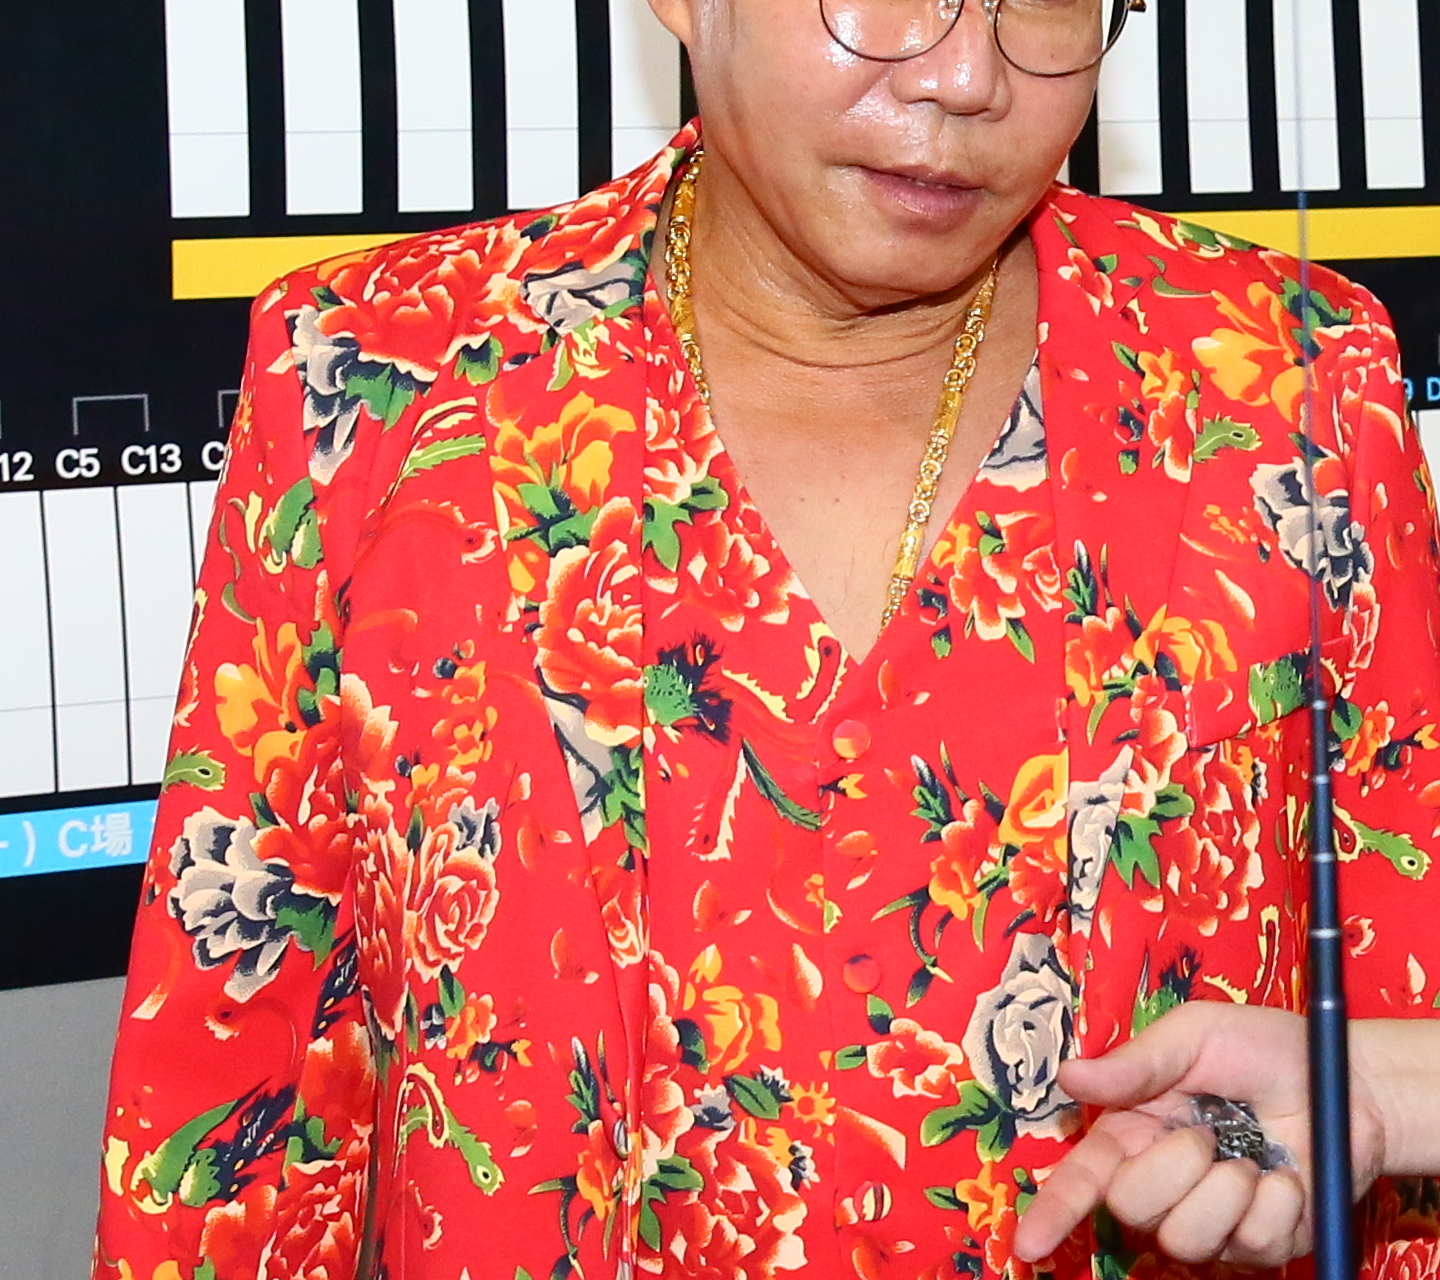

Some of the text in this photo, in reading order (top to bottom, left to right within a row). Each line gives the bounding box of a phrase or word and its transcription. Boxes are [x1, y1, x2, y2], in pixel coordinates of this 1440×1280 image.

[55, 447, 101, 479] C5
[121, 443, 182, 475] C13
[201, 441, 226, 471] C
